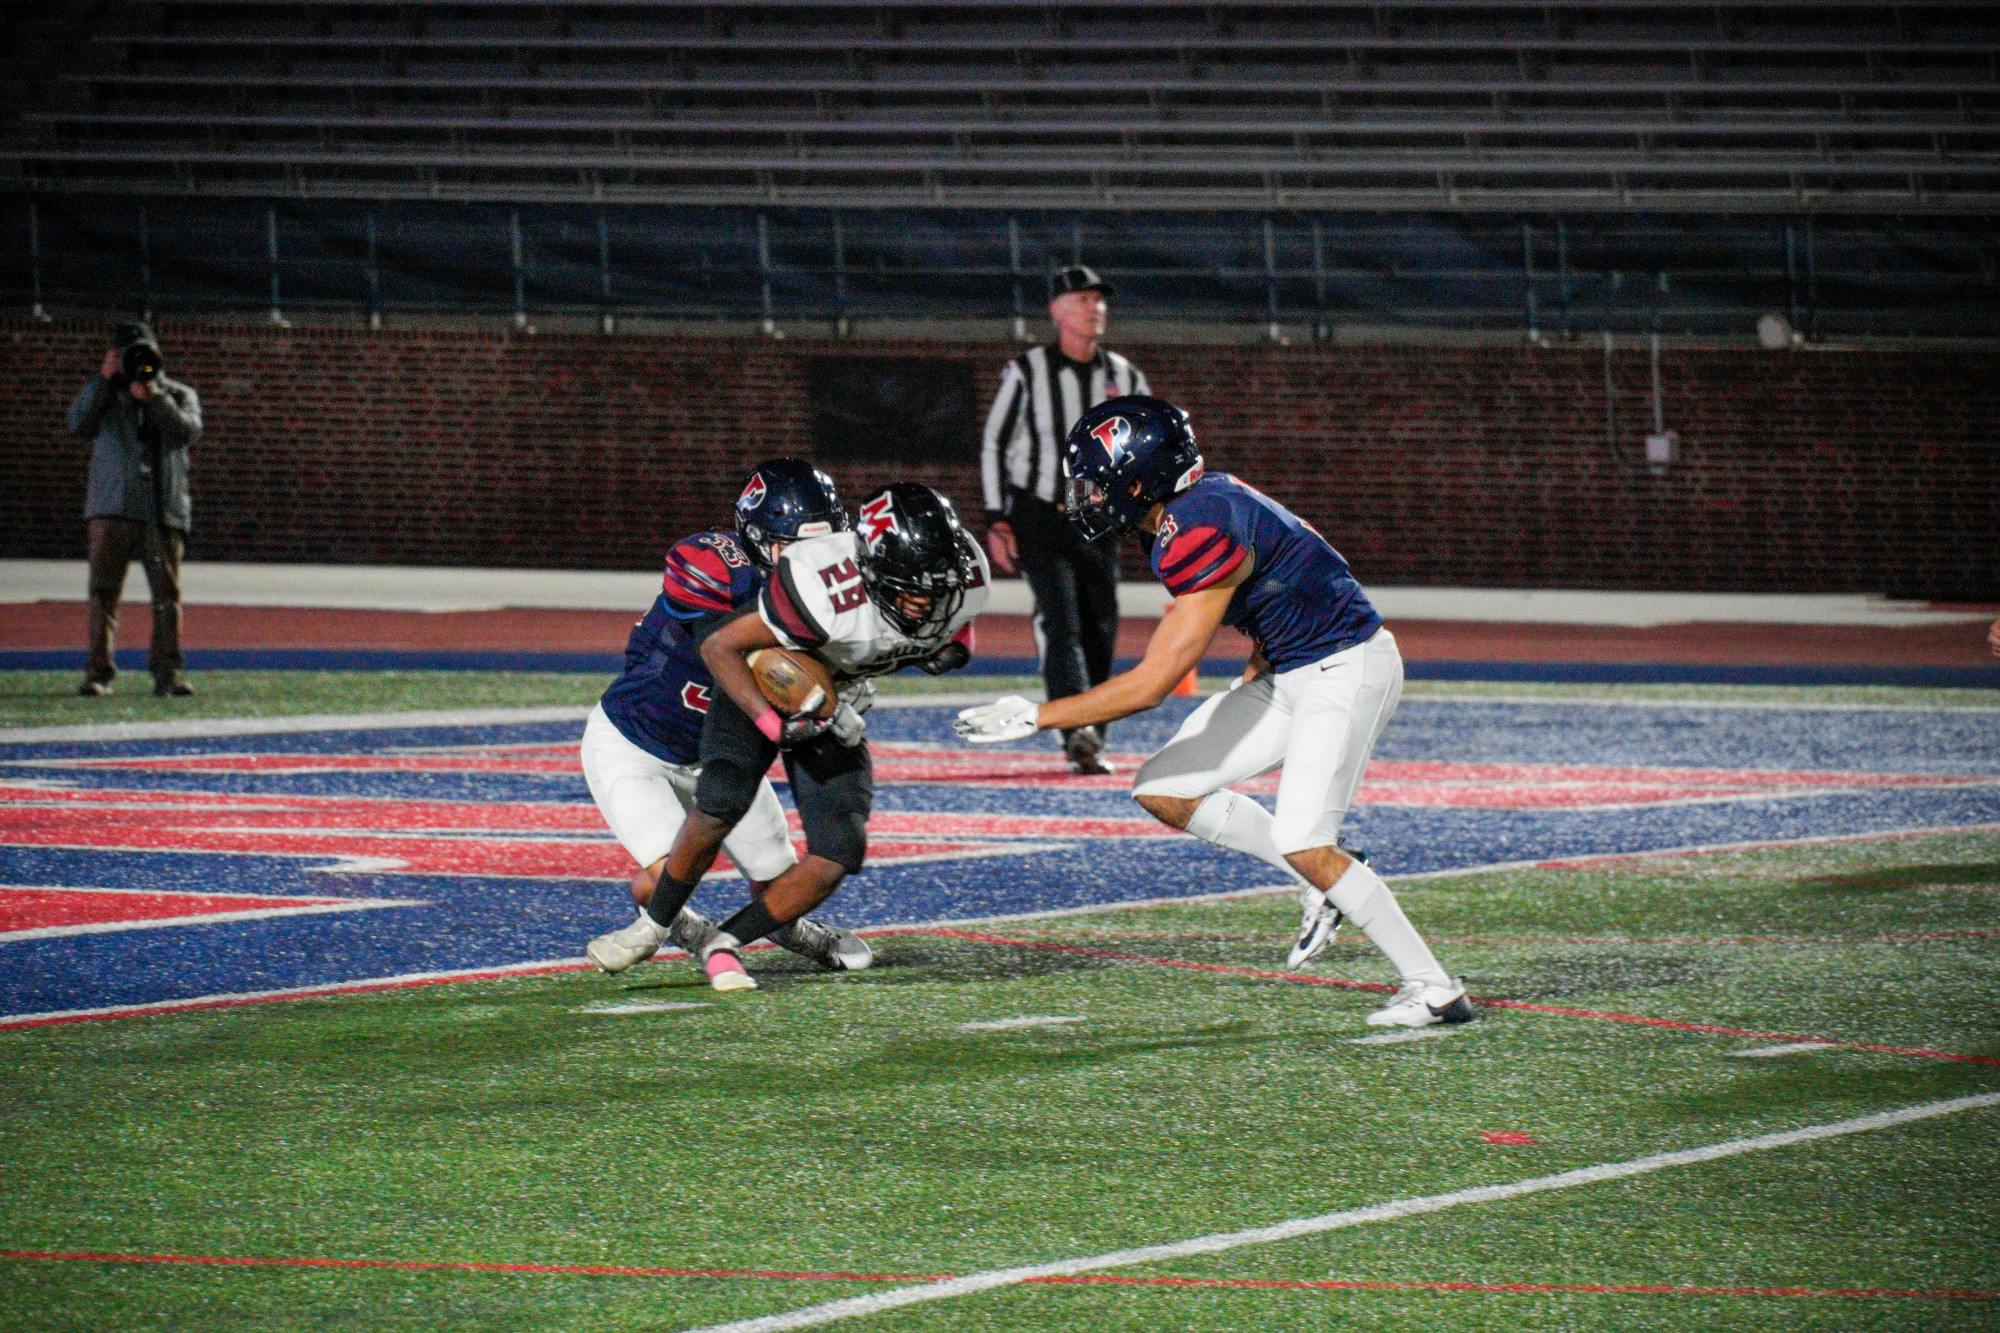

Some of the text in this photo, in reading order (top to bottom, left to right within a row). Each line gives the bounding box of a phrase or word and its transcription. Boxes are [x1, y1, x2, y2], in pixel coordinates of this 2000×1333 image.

[1091, 416, 1135, 467] P
[699, 532, 750, 568] 33
[818, 556, 869, 615] 29
